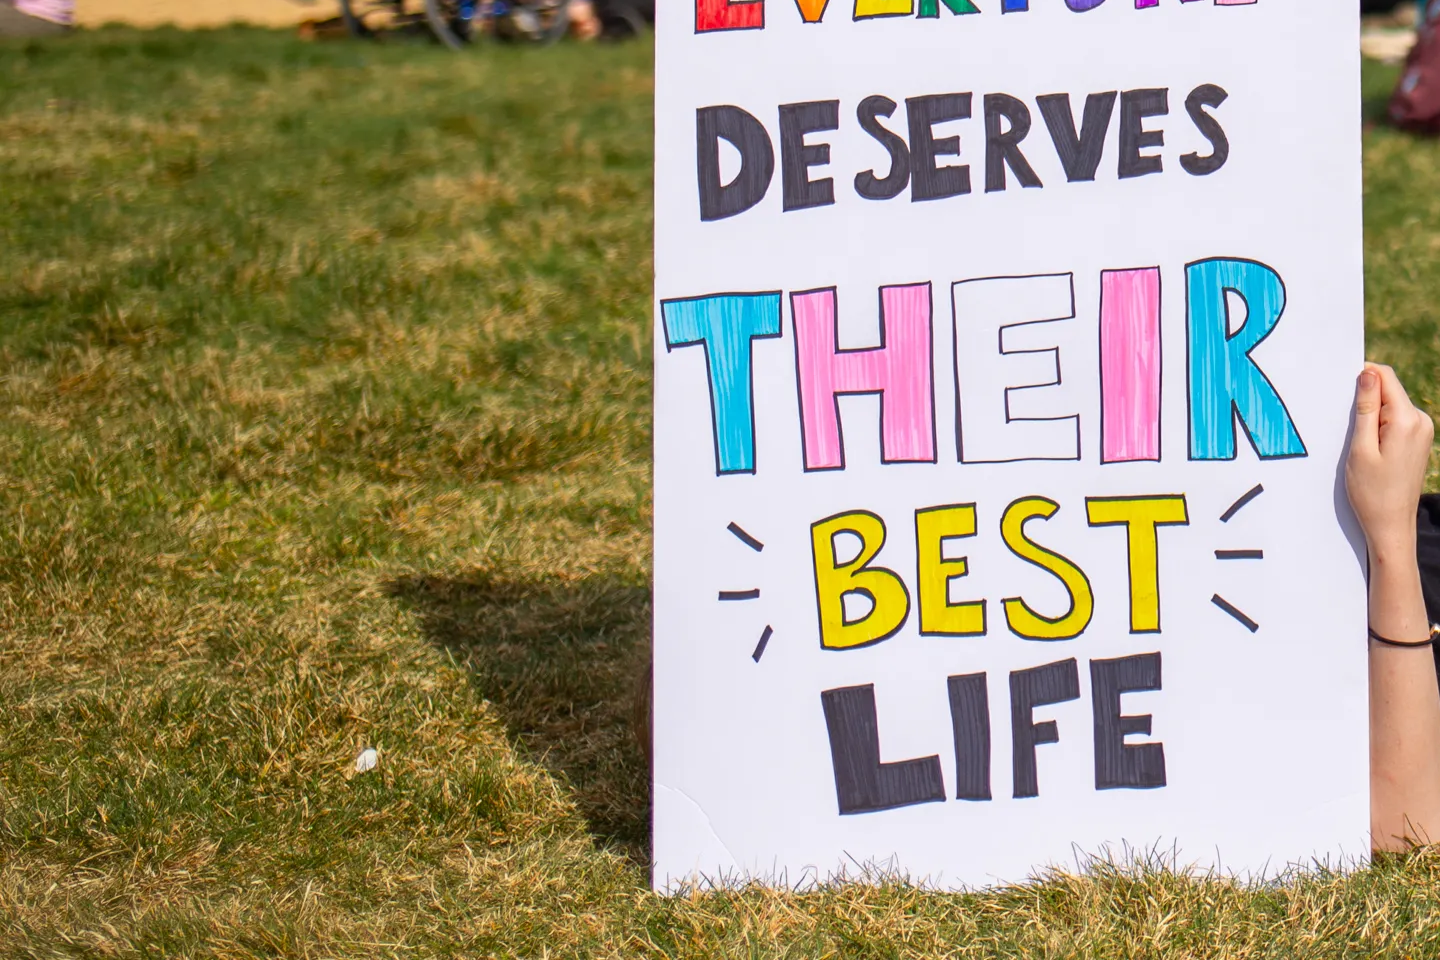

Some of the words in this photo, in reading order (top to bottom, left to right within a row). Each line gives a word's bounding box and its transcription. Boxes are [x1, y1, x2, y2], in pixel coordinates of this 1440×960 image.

[696, 84, 1229, 221] DESERVES
[660, 256, 1309, 476] THEIR
[810, 494, 1190, 651] BEST
[821, 652, 1168, 815] LIFE
